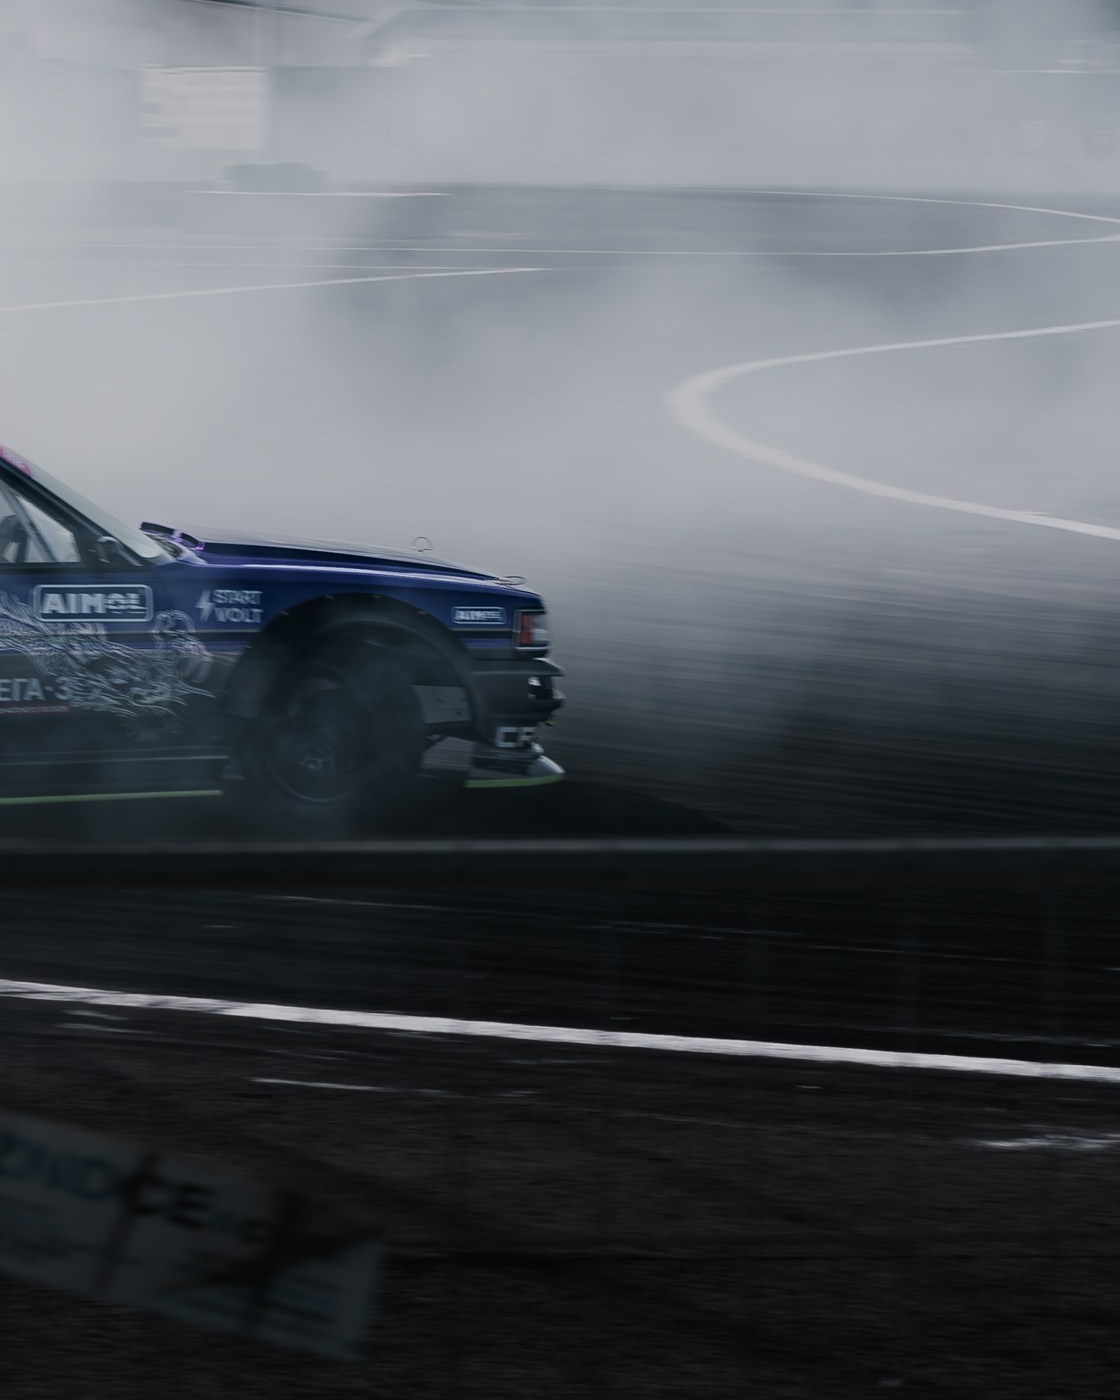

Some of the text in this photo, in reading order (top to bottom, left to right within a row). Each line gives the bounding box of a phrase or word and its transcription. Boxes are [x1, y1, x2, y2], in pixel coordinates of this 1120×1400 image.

[41, 593, 148, 615] AIMOL
[212, 588, 263, 604] START
[214, 608, 264, 623] VOLT
